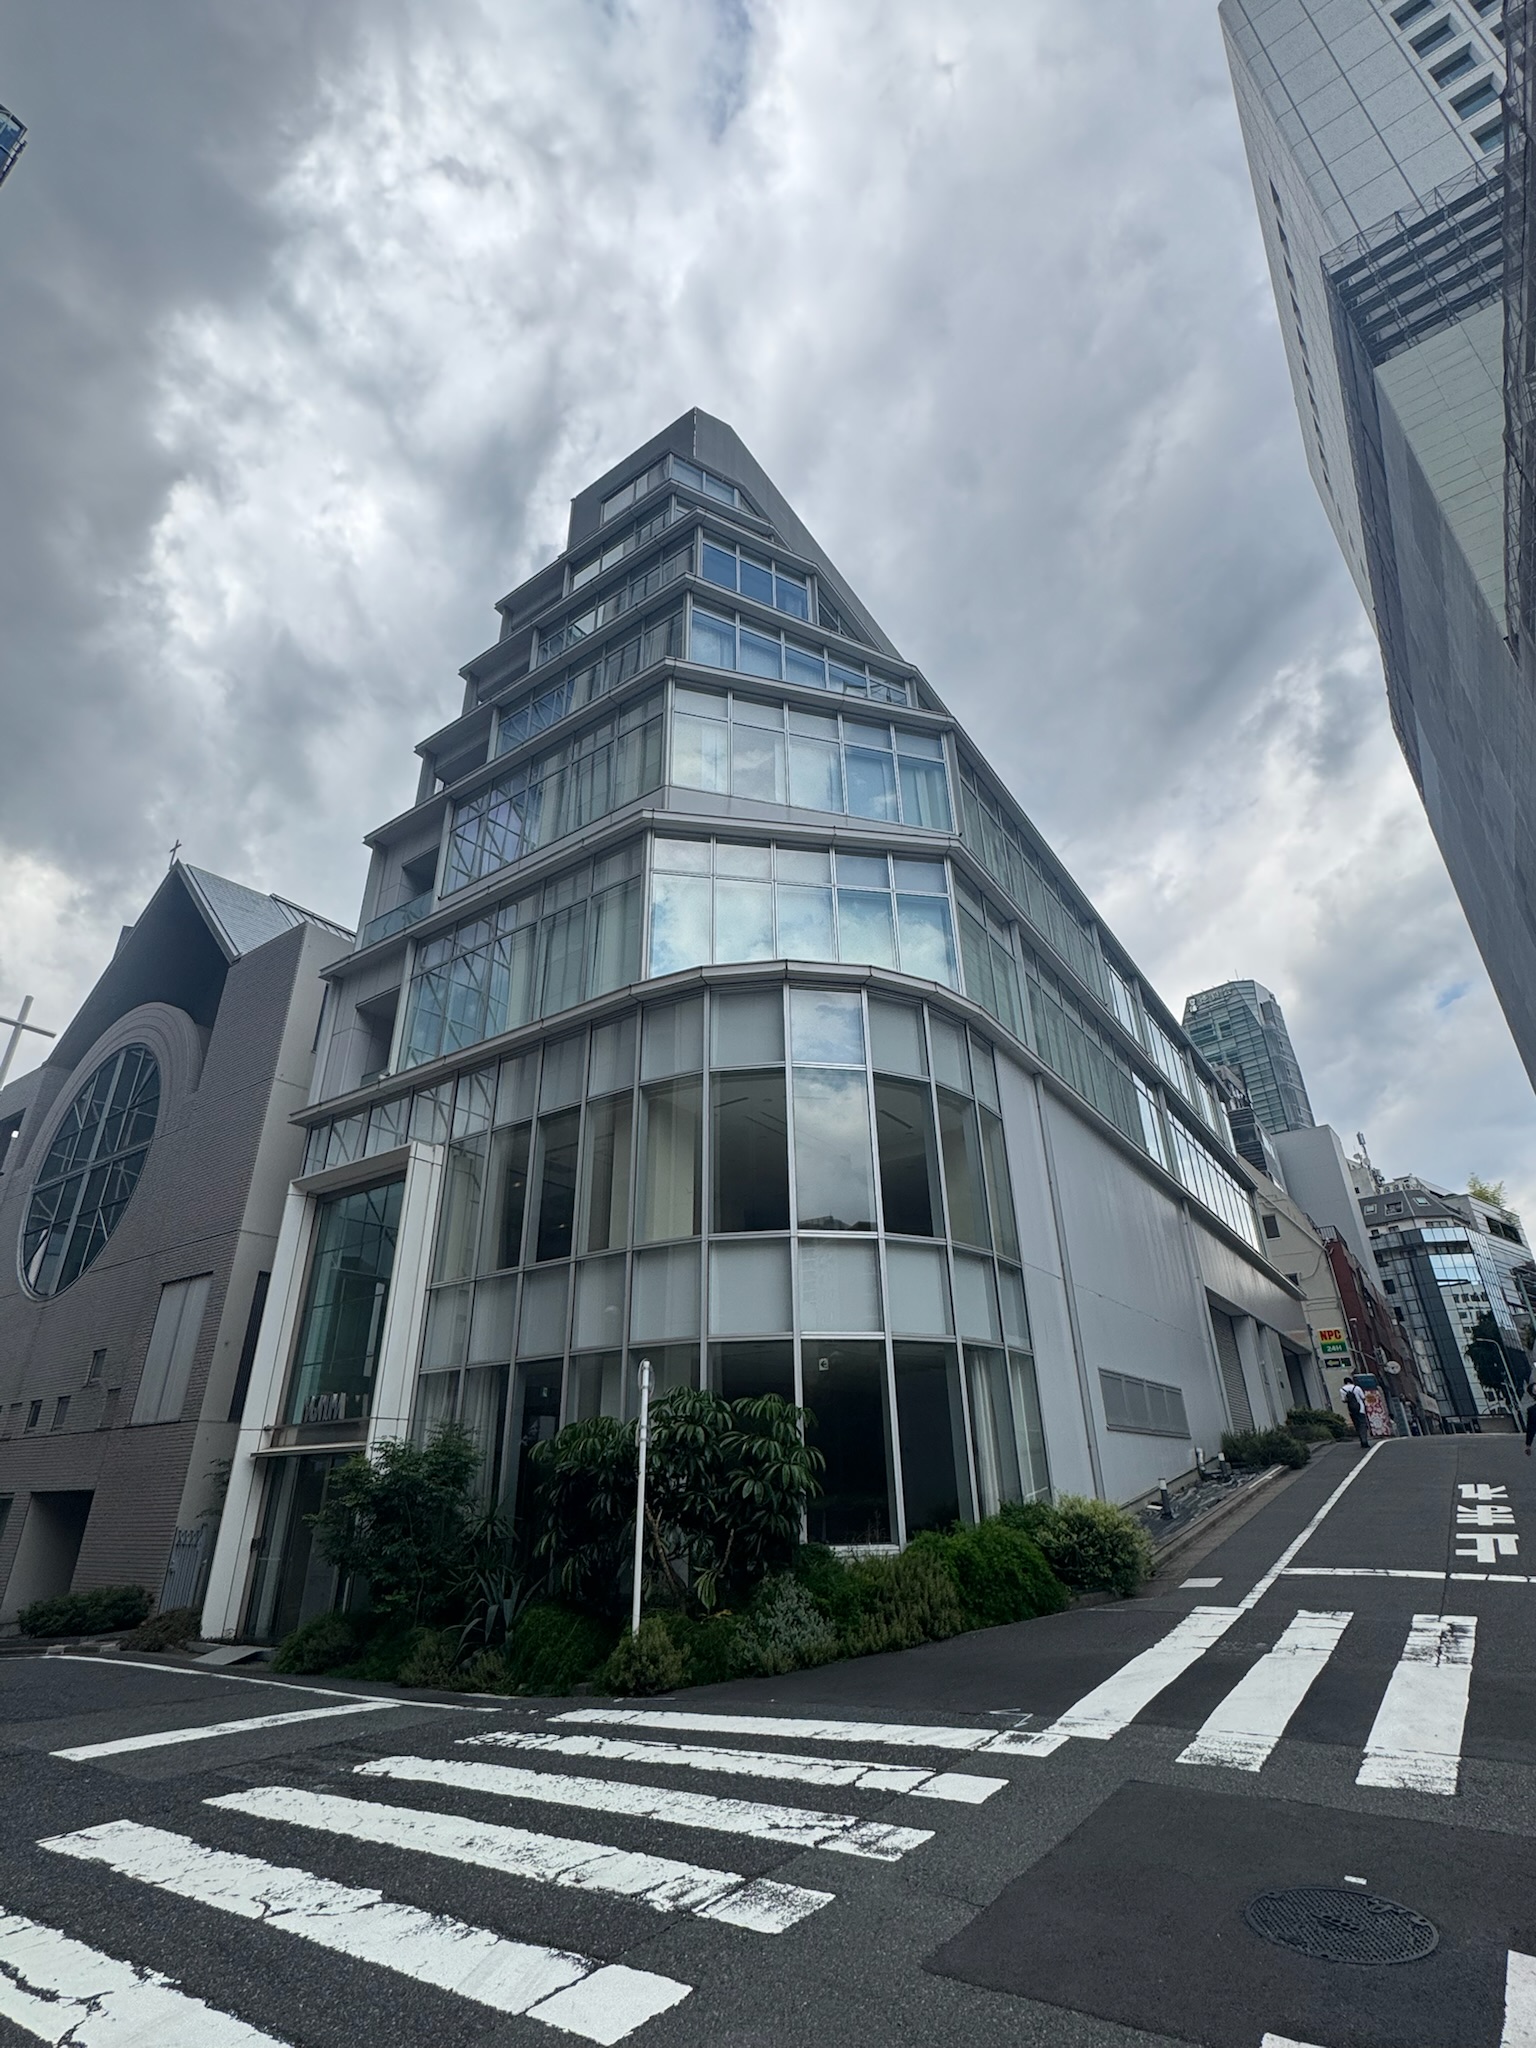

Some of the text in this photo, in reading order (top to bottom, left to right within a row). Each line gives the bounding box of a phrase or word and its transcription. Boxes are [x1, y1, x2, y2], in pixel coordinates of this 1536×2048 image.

[1319, 1329, 1342, 1341] NPC
[1326, 1344, 1342, 1352] 24H
[1455, 1483, 1519, 1563] 止まれ
